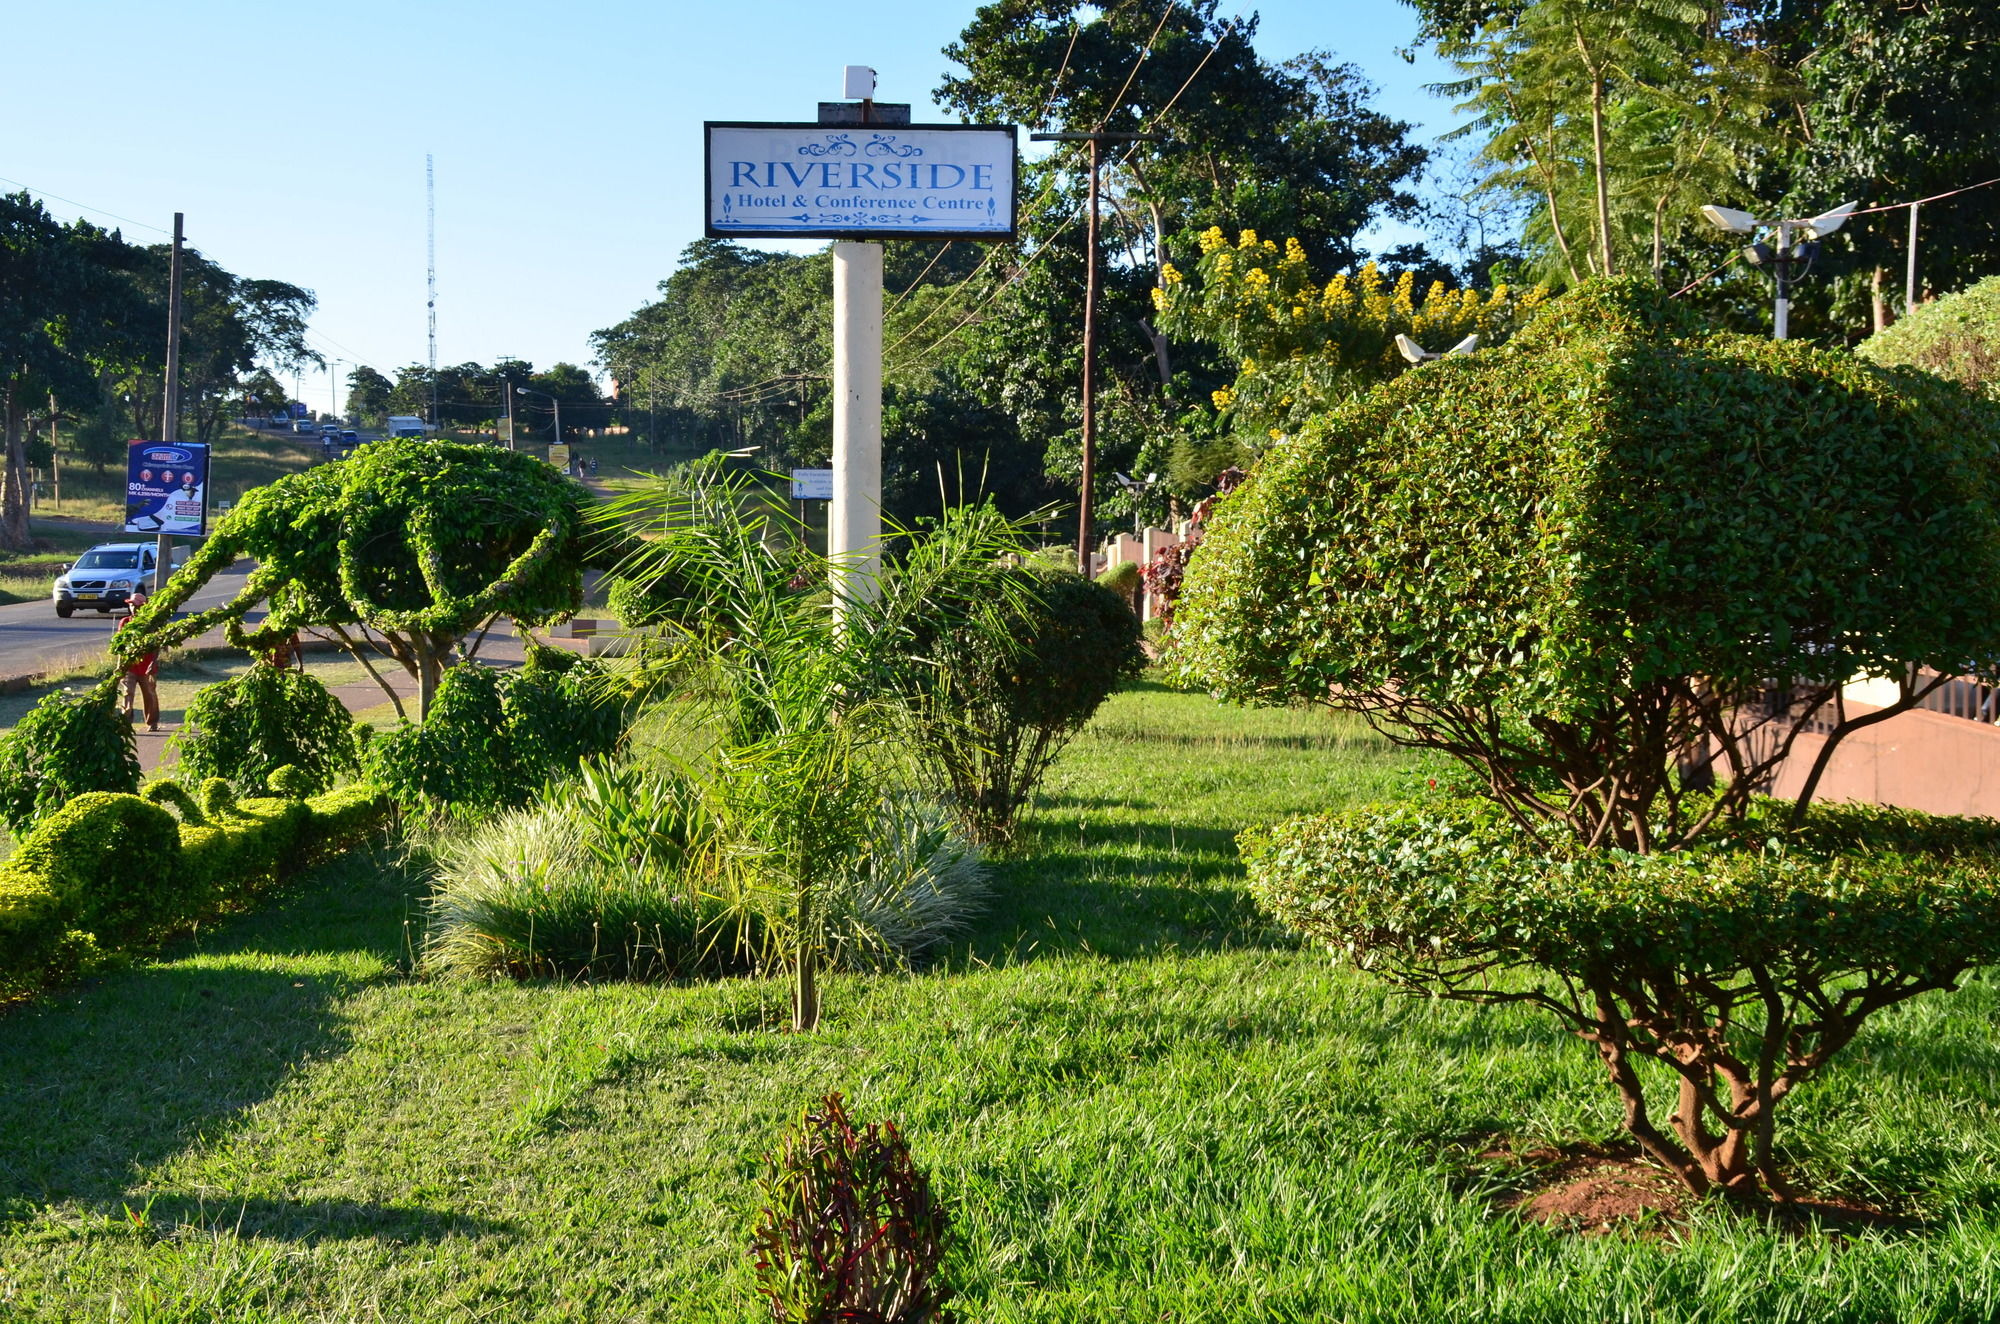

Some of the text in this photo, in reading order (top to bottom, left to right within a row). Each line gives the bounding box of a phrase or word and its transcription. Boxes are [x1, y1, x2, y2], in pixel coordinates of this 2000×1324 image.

[728, 161, 993, 191] RIVERSIDE
[738, 194, 984, 210] Hotel & Conference Centre
